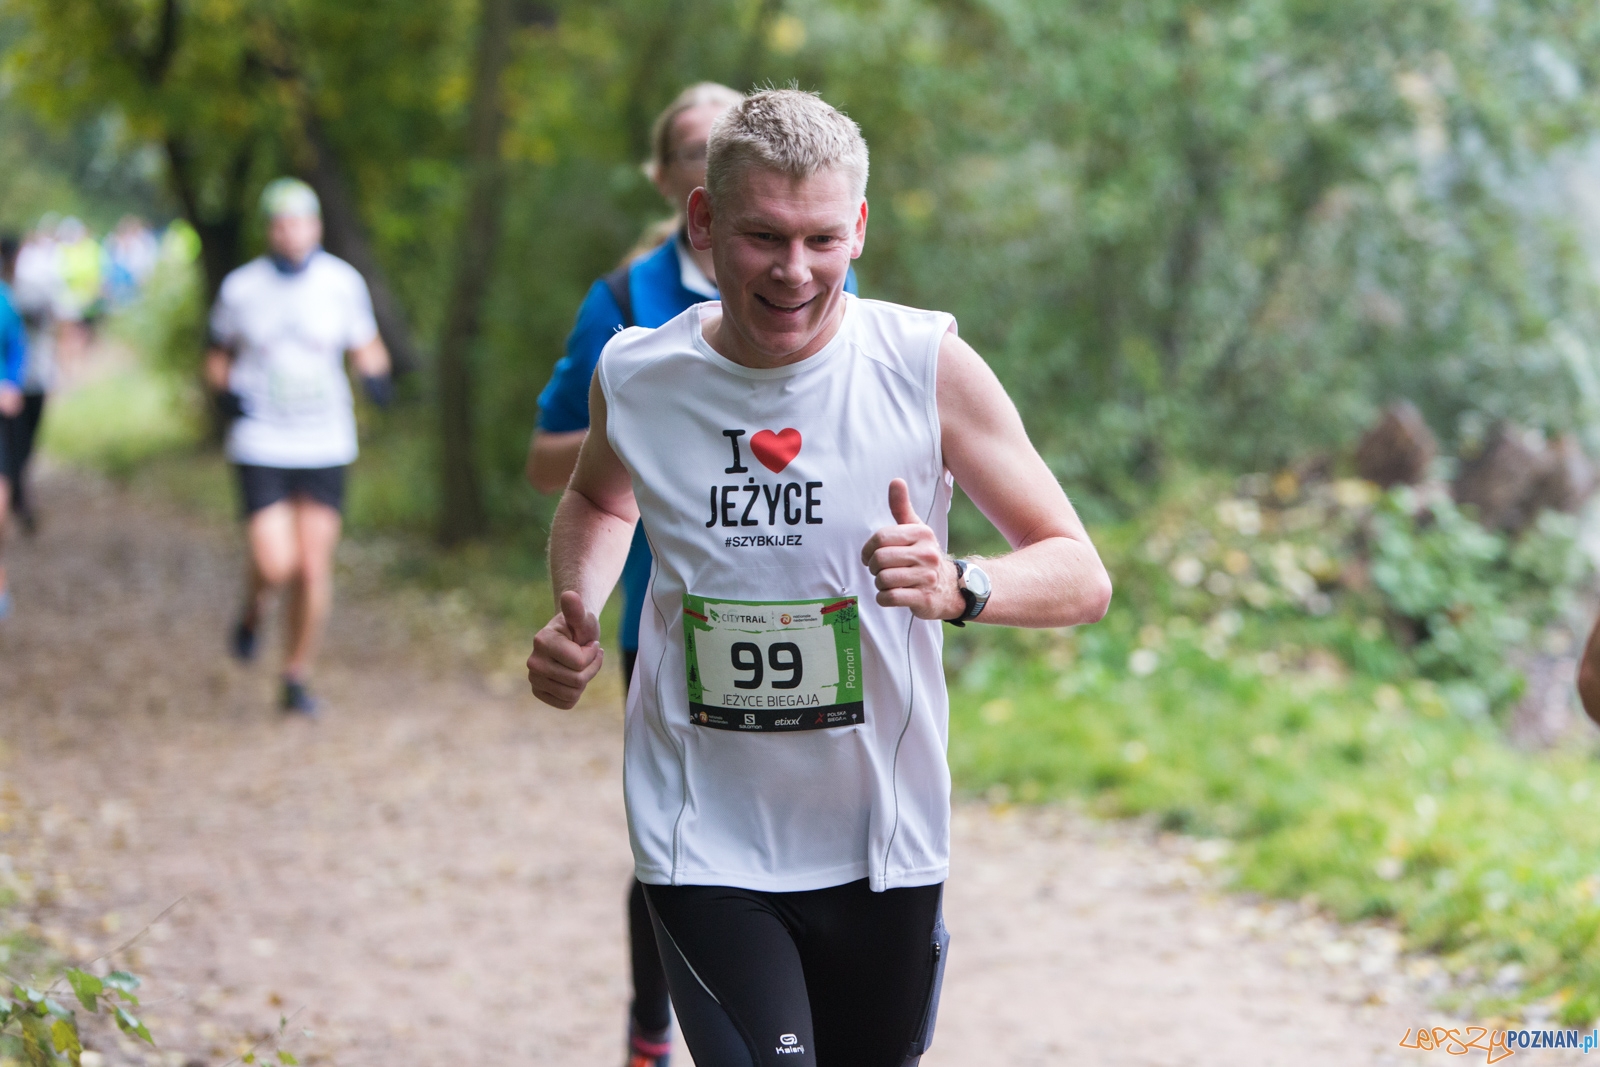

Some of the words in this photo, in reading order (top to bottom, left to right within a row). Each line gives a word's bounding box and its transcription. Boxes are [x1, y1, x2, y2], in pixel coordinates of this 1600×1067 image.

[722, 429, 749, 474] I
[705, 477, 823, 528] JEŻYCE
[725, 535, 802, 547] #SZYBKIJEZ
[730, 641, 803, 690] 99
[844, 647, 856, 689] Poznań
[722, 693, 764, 707] JEŻYCE
[767, 693, 820, 707] BIEGAJĄ
